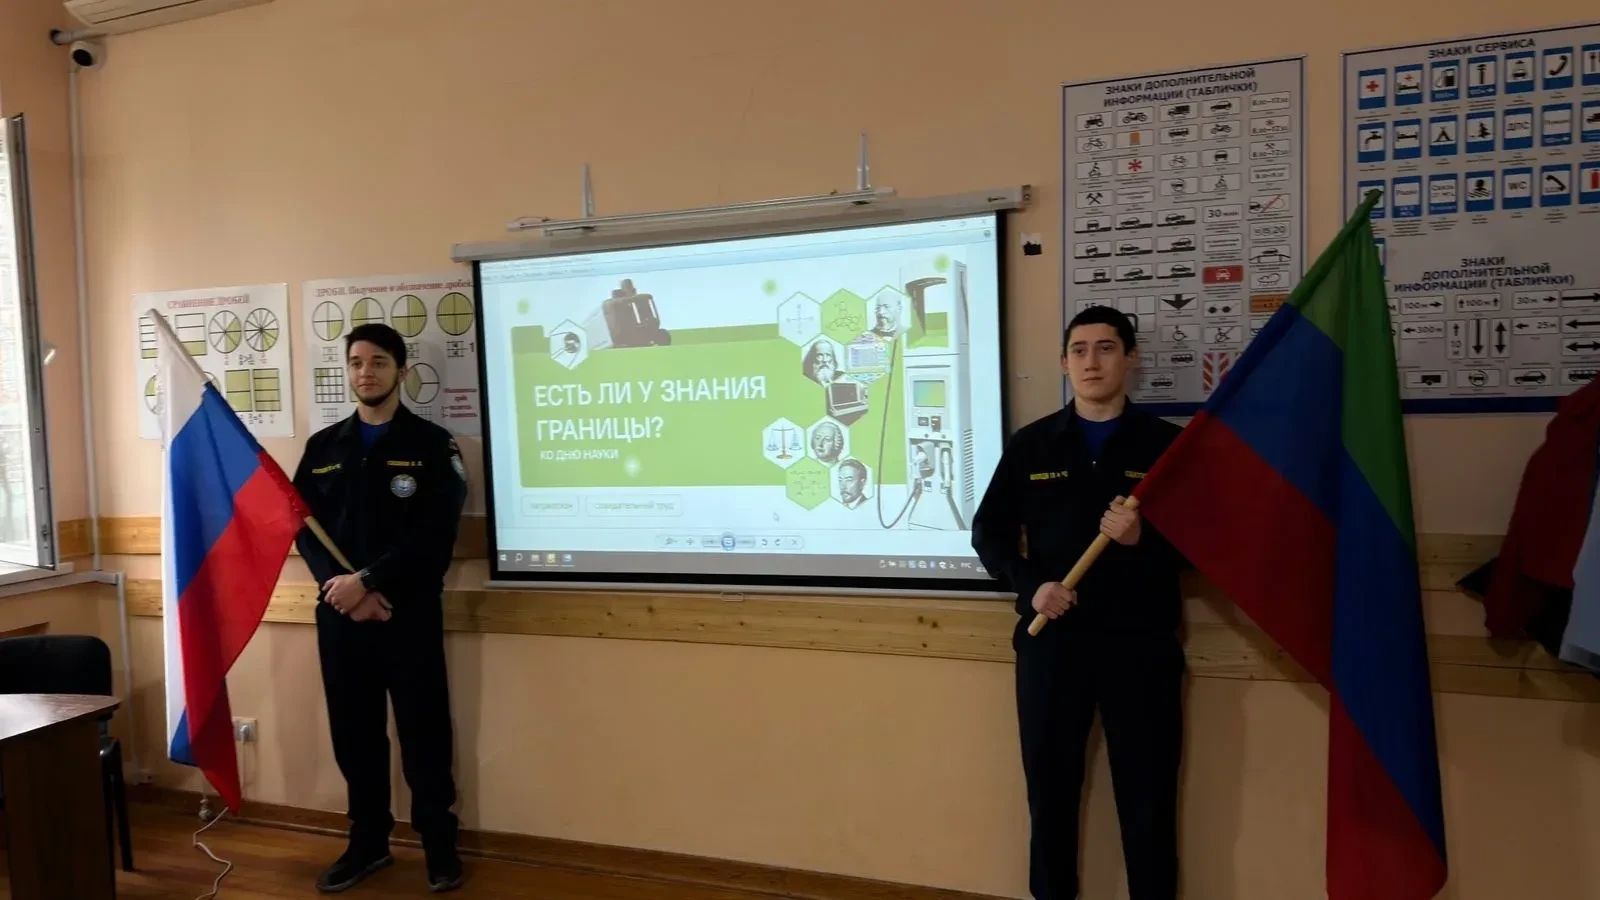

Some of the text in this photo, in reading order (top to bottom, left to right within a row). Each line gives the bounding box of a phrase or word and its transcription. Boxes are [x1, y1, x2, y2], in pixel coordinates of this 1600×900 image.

[1428, 38, 1536, 59] ЗНАКИ СЕРВИСА
[1105, 68, 1256, 95] ЗНАКИ ДОПОЛНИТЕЛЬНОЙ
[1103, 81, 1258, 107] ИНФОРМАЦИИ (ТАБЛИЧКИ)
[1507, 181, 1527, 190] WC
[1208, 209, 1221, 218] 30
[1422, 262, 1551, 282] ДОПОЛНИТЕЛЬНОЙ
[1461, 256, 1506, 268] ЗНАКИ
[1394, 274, 1576, 292] ИНФОРМАЦИИ (ТАБЛИЧКИ)
[534, 376, 767, 406] ЕСТЬ ЛИ У ЗНАНИЯ
[536, 416, 664, 443] ГРАНИЦЫ?
[540, 449, 619, 460] КО ДНЮ НАУКИ
